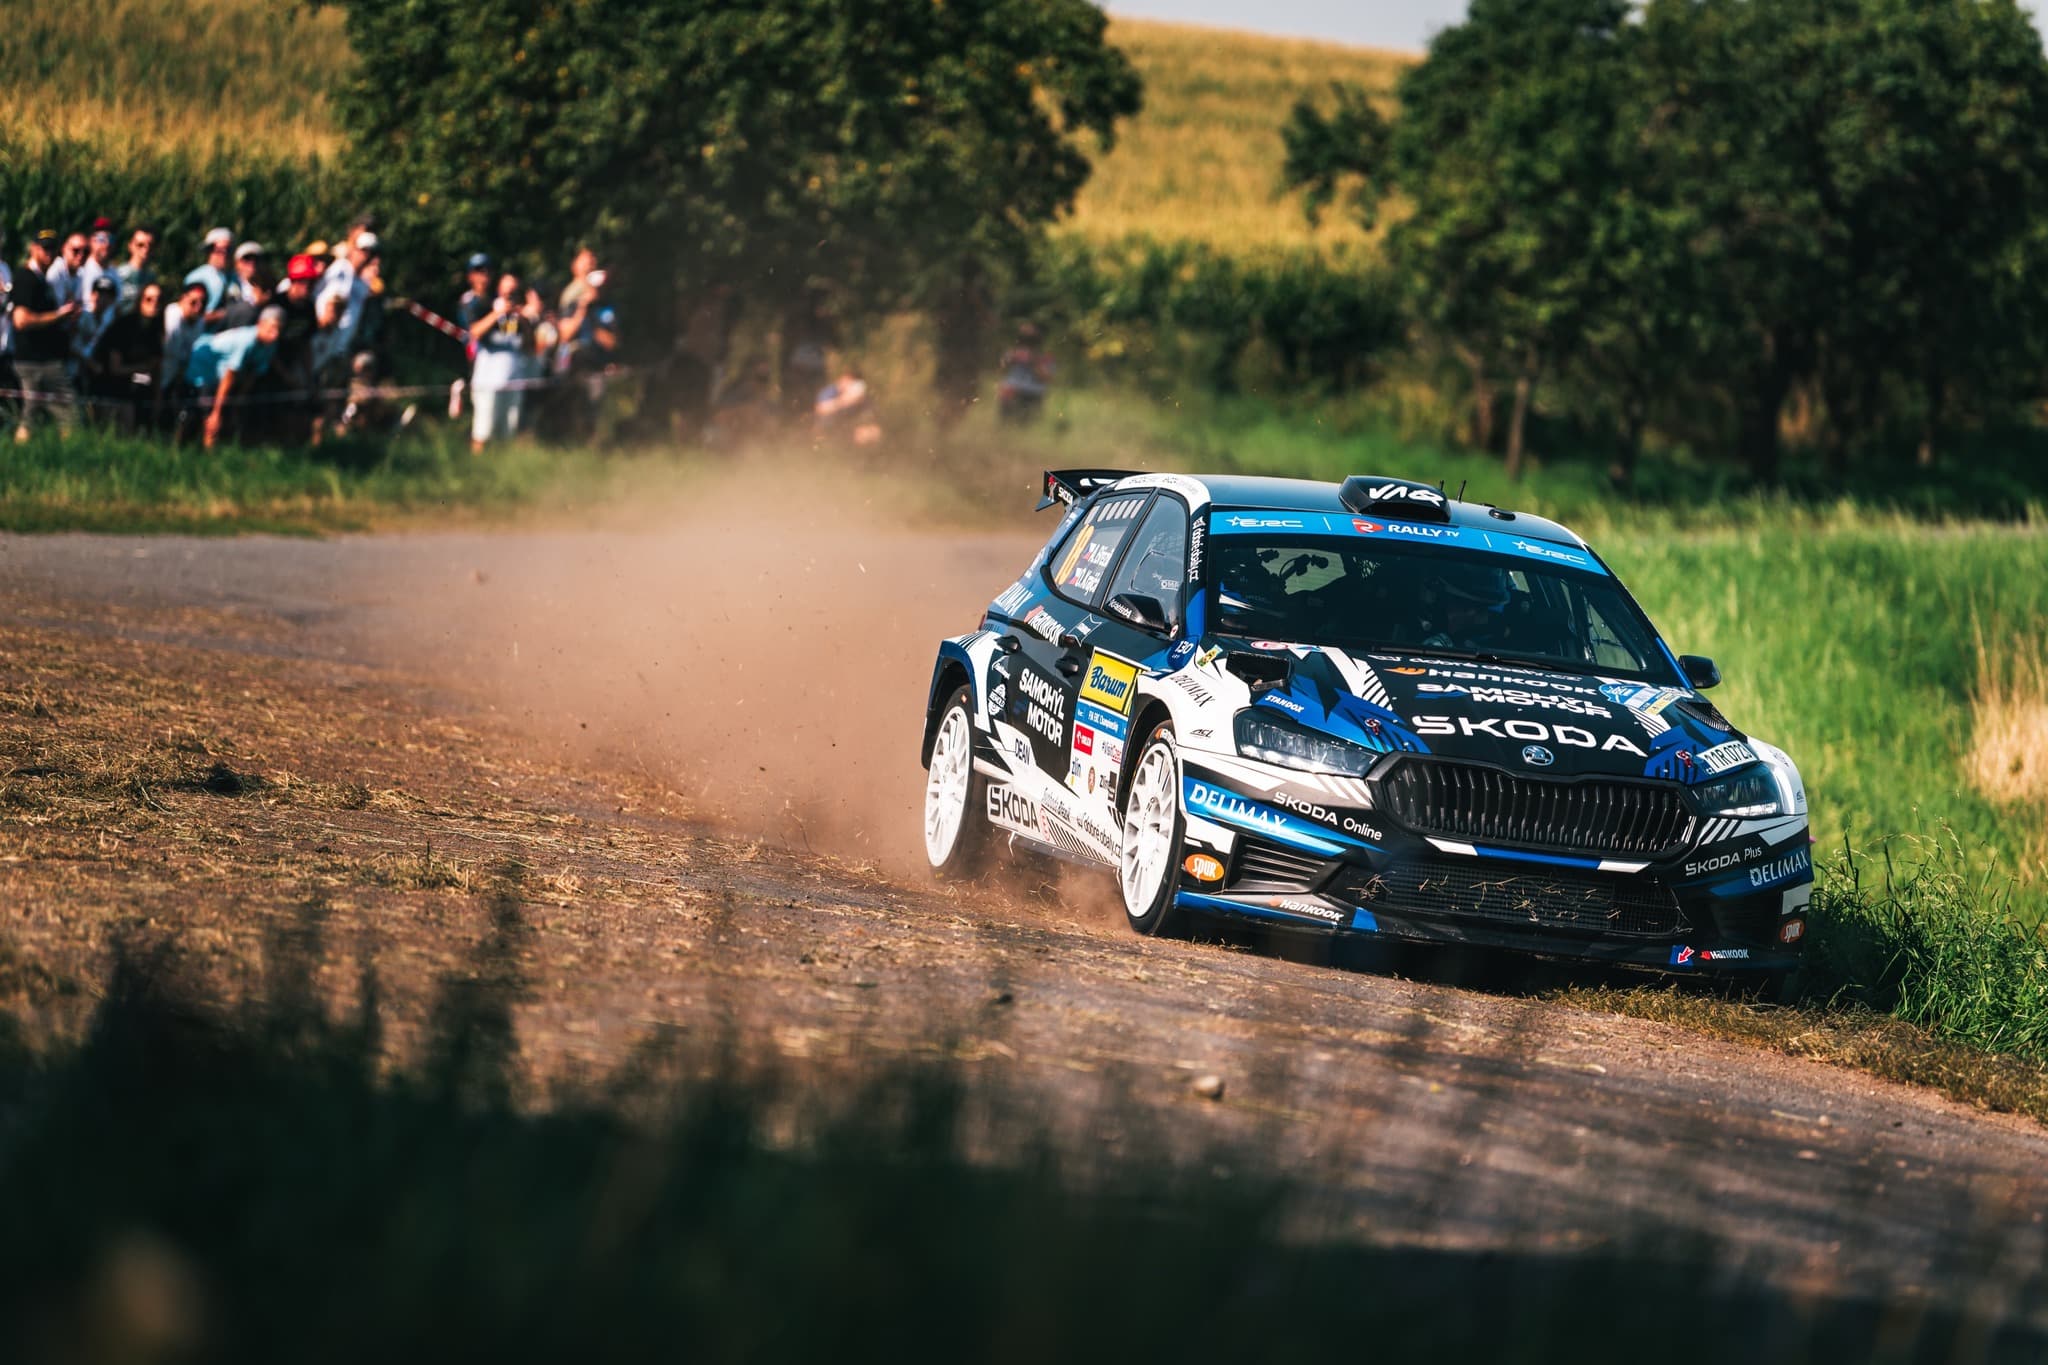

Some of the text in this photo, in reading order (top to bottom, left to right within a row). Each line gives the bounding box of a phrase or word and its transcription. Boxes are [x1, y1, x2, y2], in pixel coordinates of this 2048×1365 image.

[1238, 517, 1303, 528] ERC
[1388, 524, 1460, 538] RALLY TV
[1523, 545, 1587, 565] ERC
[1175, 640, 1194, 655] 130
[1019, 668, 1065, 720] SAMOHÝL
[1090, 666, 1128, 698] Barum
[1264, 695, 1304, 712] STANDOX
[1472, 693, 1613, 719] MOTOR
[1026, 702, 1063, 748] MOTOR
[1014, 738, 1030, 765] DEAN
[1189, 783, 1288, 833] DELIMAX
[1343, 817, 1383, 841] Online
[1744, 846, 1762, 862] Plus
[1750, 849, 1809, 887] DELIMAX
